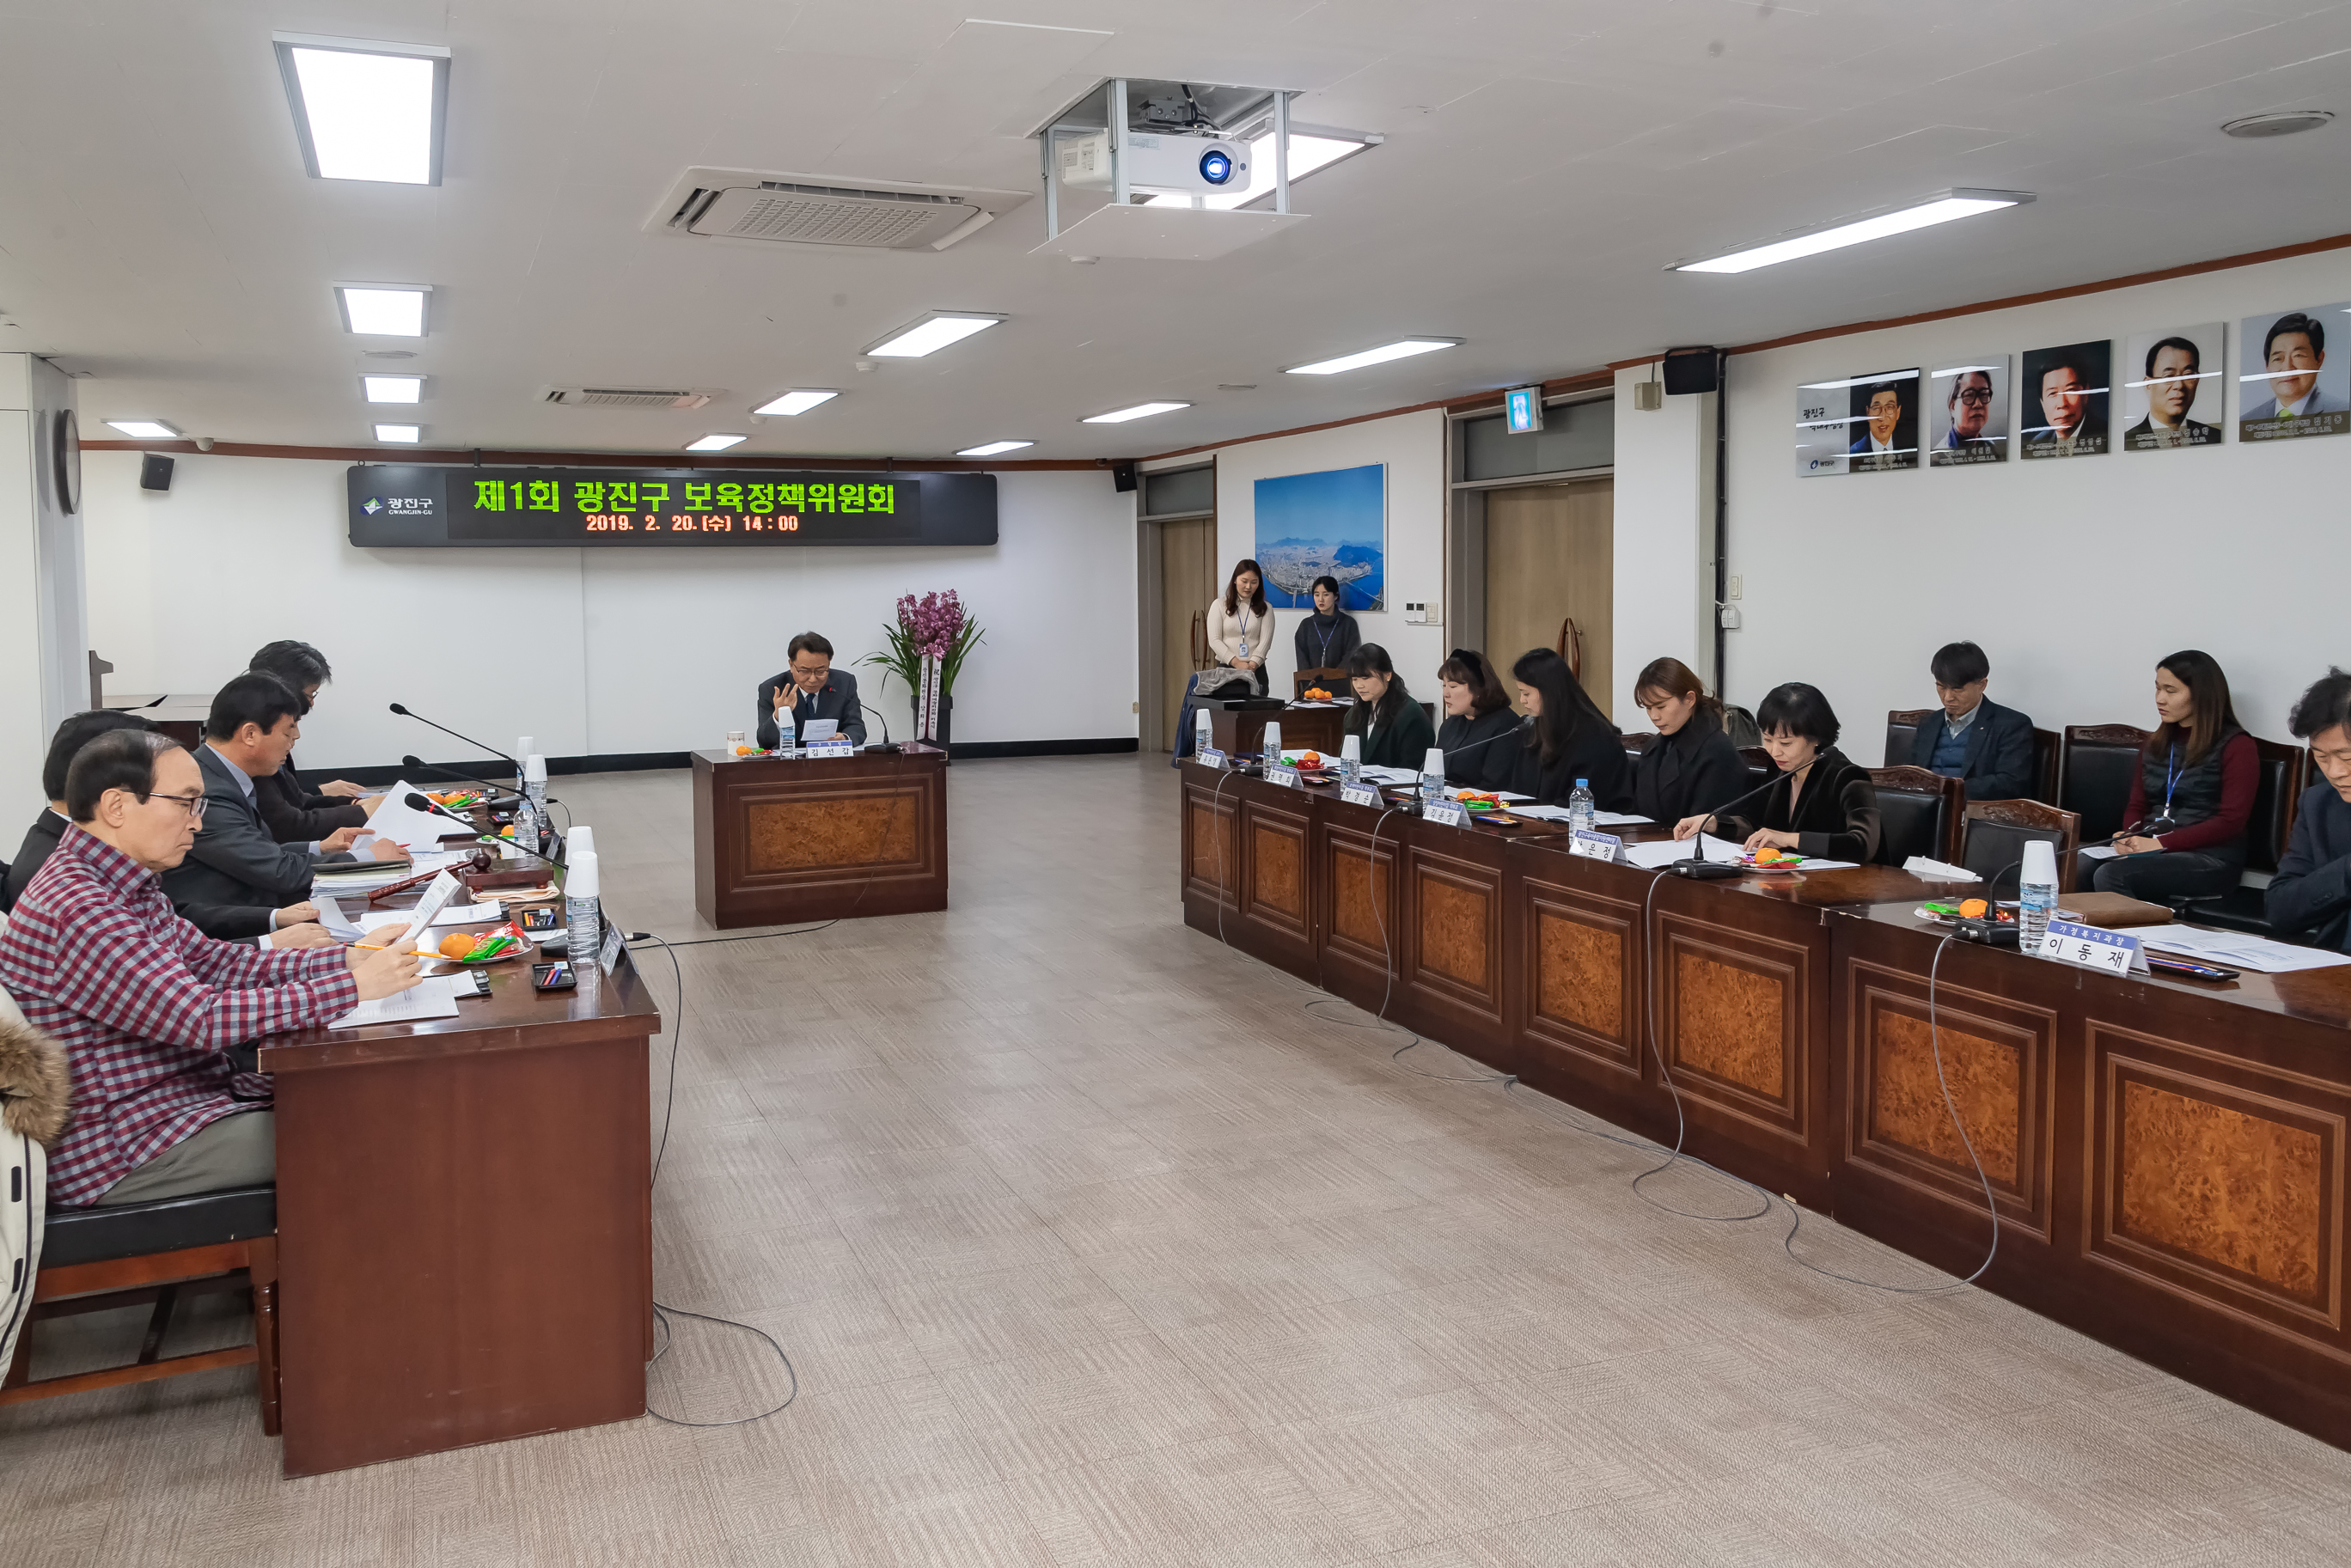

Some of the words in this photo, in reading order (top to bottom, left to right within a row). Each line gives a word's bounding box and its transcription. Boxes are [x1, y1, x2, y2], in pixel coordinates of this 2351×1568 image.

[1803, 407, 1825, 419] 광진구
[387, 497, 434, 509] 광진구
[473, 480, 559, 513] 제1회
[573, 481, 670, 513] 광진구
[684, 482, 895, 515] 보육정책위원회
[586, 515, 634, 531] 2019.
[644, 515, 661, 531] 2.
[810, 747, 850, 757] 김선갑
[2059, 924, 2125, 947] 가정복지과장
[2049, 938, 2125, 969] 이동재
